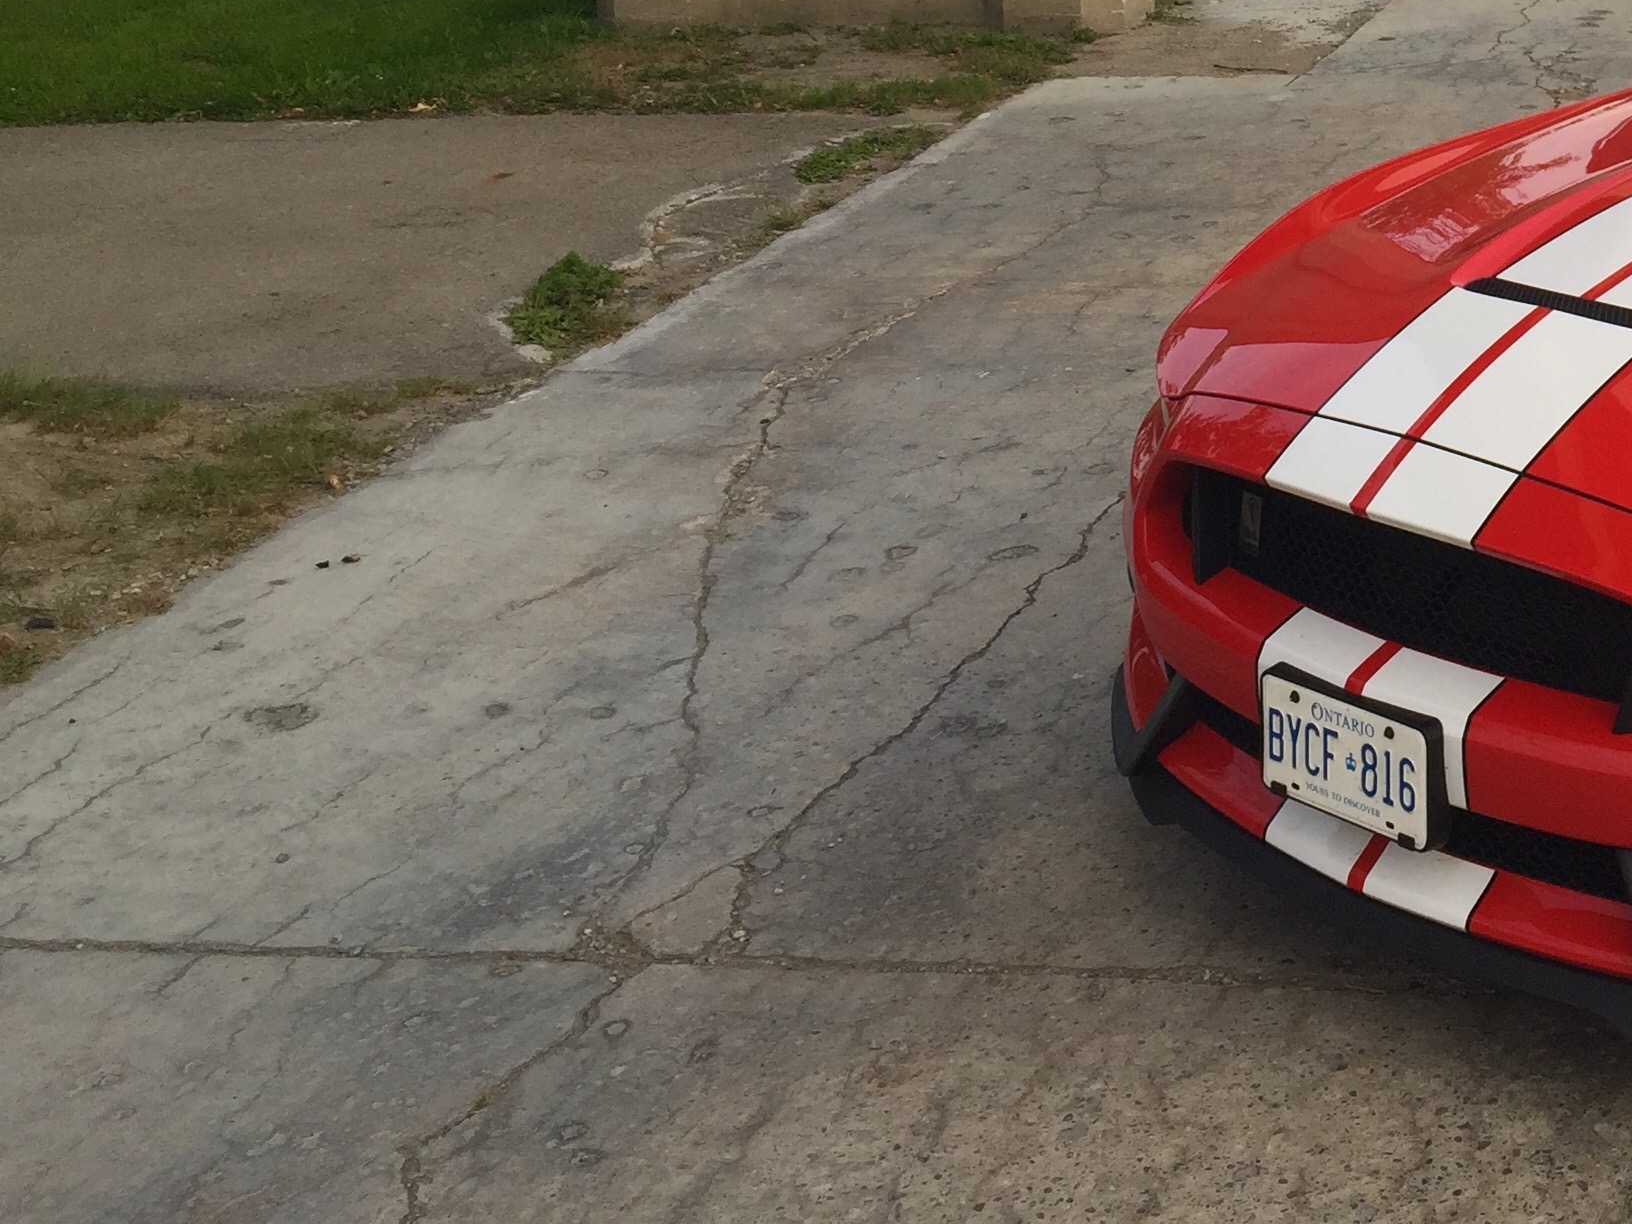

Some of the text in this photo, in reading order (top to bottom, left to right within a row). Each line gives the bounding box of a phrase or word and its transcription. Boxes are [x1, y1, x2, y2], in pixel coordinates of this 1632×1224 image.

[1311, 701, 1375, 738] ONTARIO
[1268, 706, 1416, 813] BYCF 816
[1305, 781, 1381, 818] YOURS TO DISCOVER
